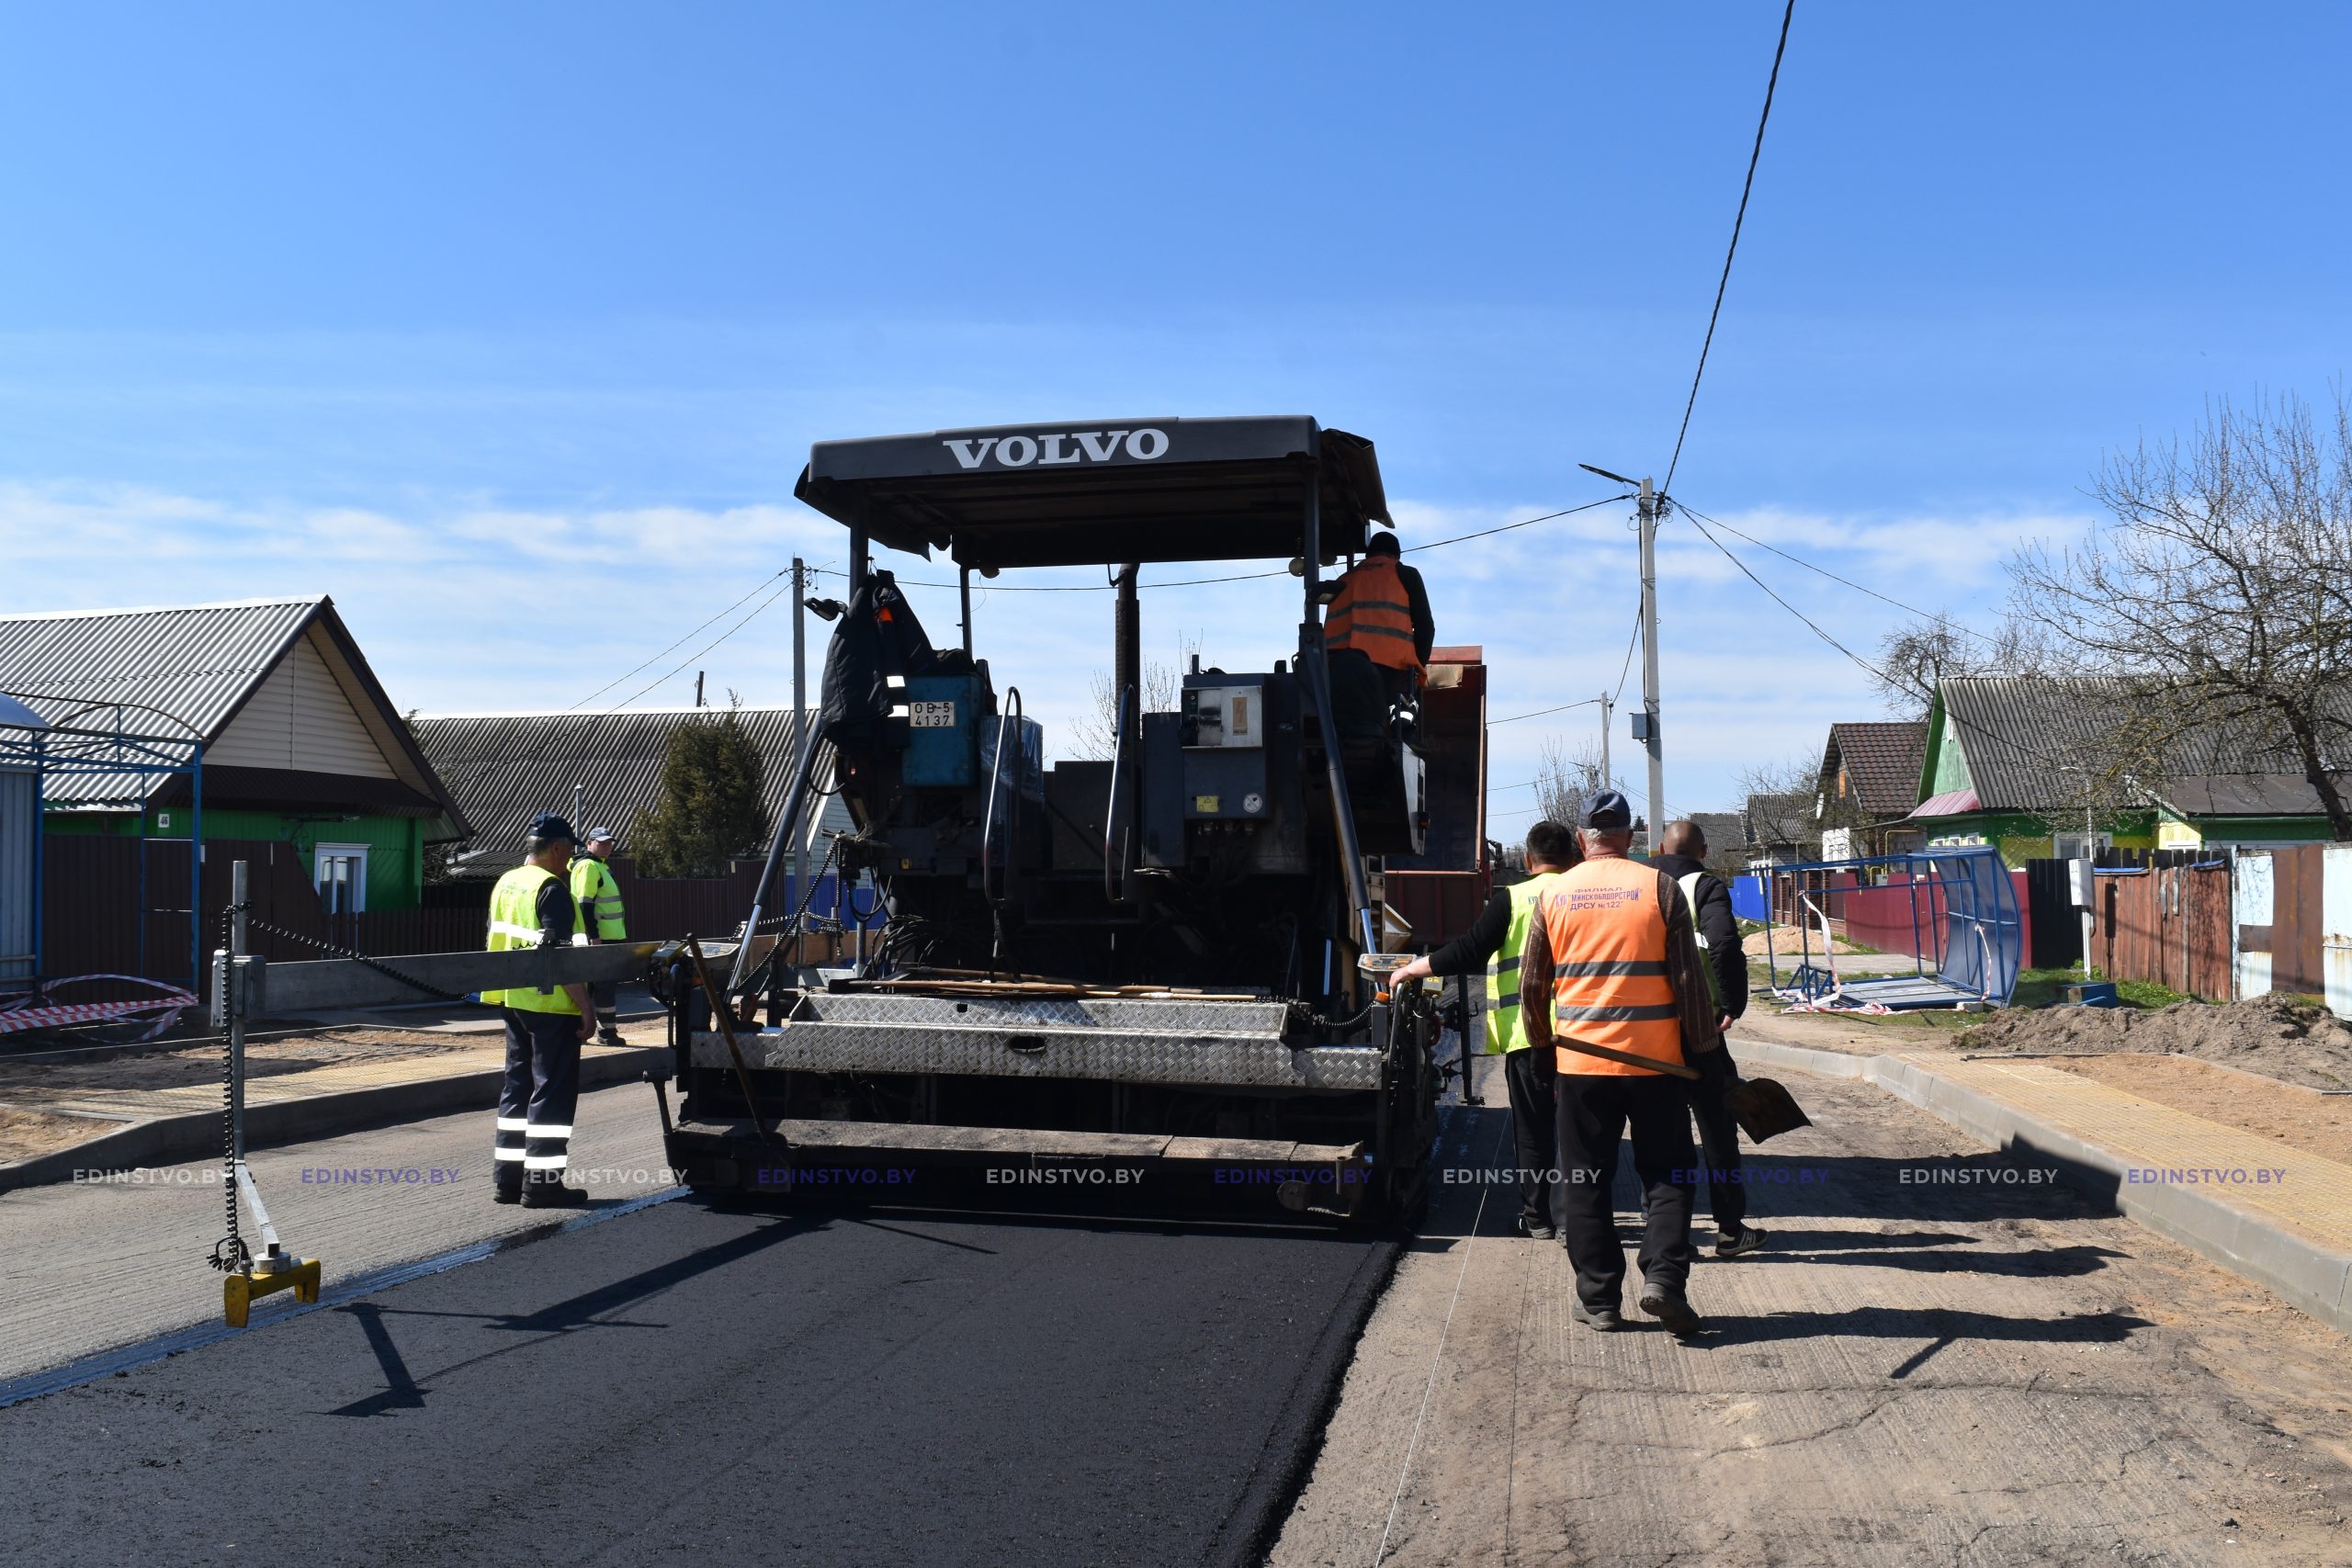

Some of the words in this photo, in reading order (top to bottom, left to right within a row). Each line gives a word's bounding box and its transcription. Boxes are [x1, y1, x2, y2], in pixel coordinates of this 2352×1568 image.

[943, 429, 1170, 468] VOLVO
[915, 716, 950, 726] 4137
[1555, 894, 1567, 908] КУП
[1569, 902, 1596, 912] ДРСУ
